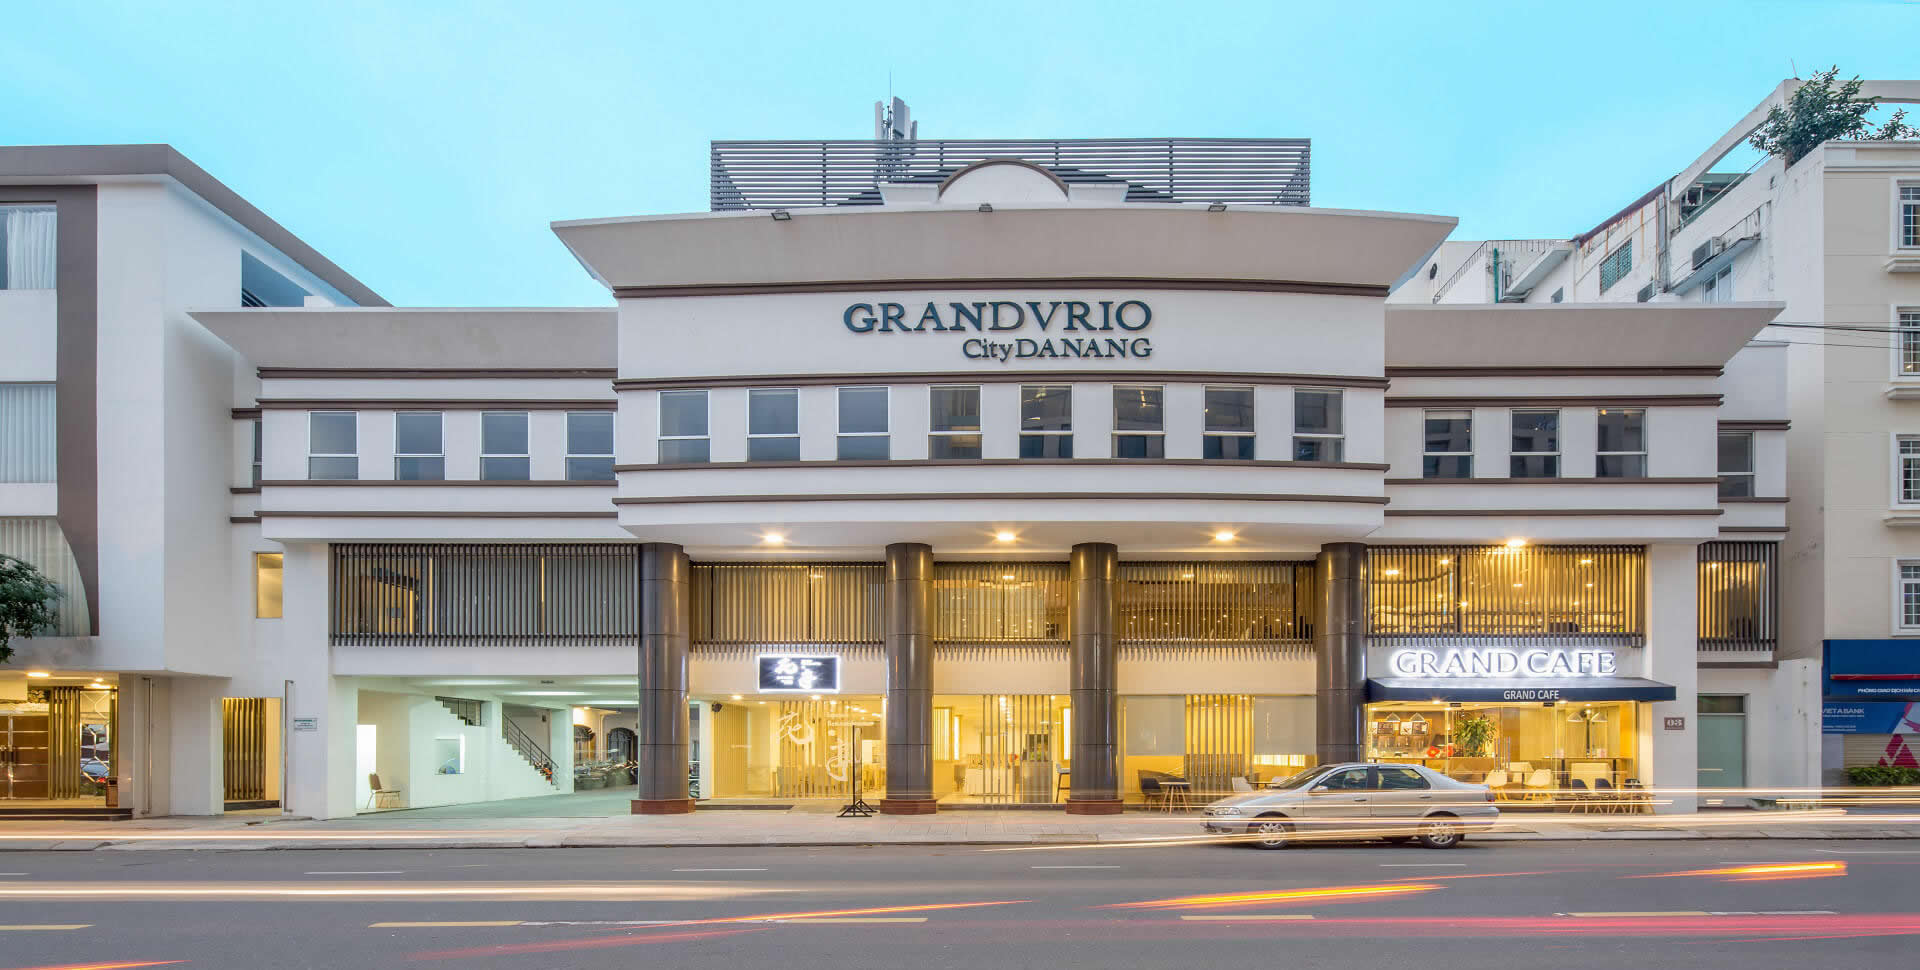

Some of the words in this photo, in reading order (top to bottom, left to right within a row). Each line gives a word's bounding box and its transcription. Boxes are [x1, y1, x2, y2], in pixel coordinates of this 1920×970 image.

[843, 300, 1153, 333] GRANDVRIO
[1396, 651, 1518, 674] GRAND
[1527, 651, 1617, 674] CAFE
[1503, 690, 1536, 700] GRAND
[1537, 690, 1560, 700] CAFE
